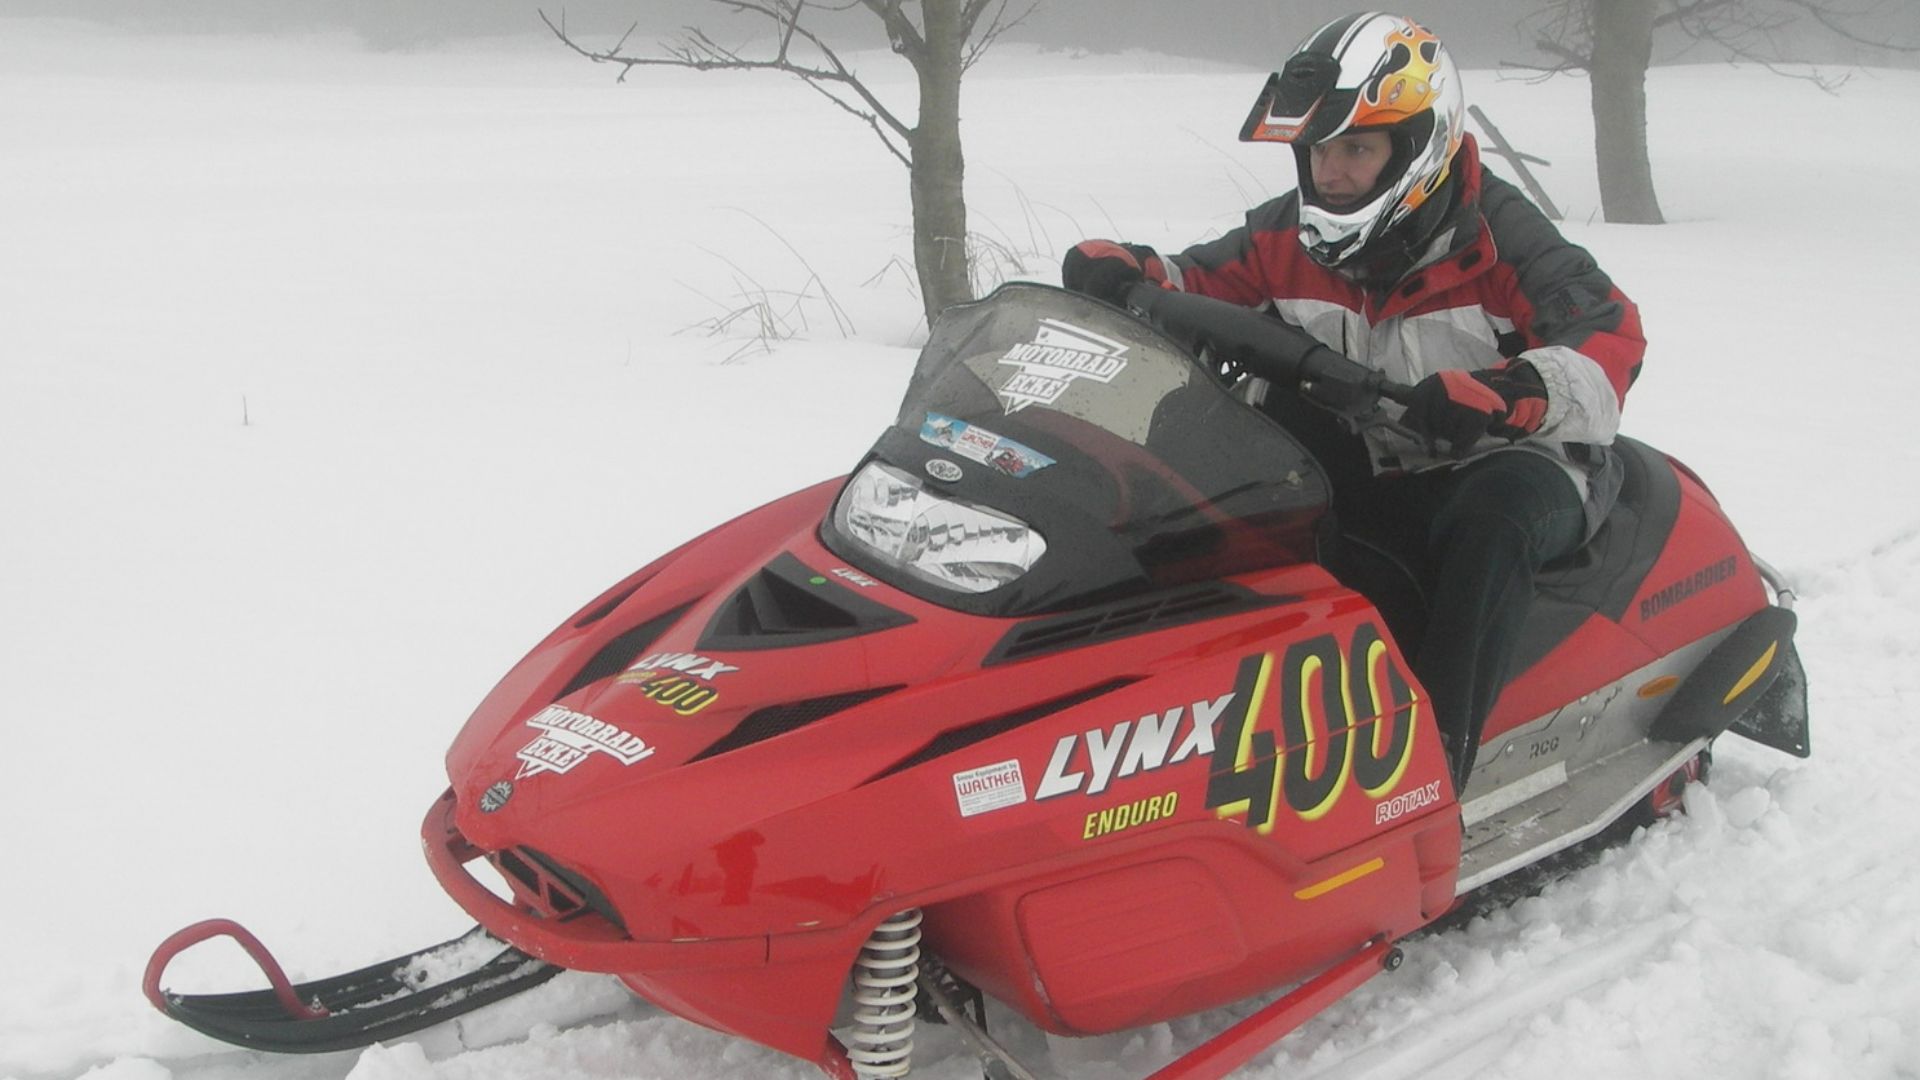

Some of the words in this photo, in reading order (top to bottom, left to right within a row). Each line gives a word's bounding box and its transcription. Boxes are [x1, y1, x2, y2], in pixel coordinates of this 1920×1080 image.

[1003, 343, 1119, 376] MOTORRAD
[1006, 374, 1062, 398] ECKE
[831, 567, 878, 587] LYNX
[1639, 555, 1737, 622] BOMBARDIER
[628, 652, 740, 681] LYNX
[640, 676, 719, 716] 400
[533, 707, 647, 756] MOTORRAD
[1034, 692, 1236, 800] LYNX
[1203, 621, 1418, 836] 400
[523, 740, 579, 767] ECKE
[958, 769, 1020, 796] WALTHER
[1083, 791, 1180, 840] ENDURO
[1375, 779, 1441, 825] ROTAX
